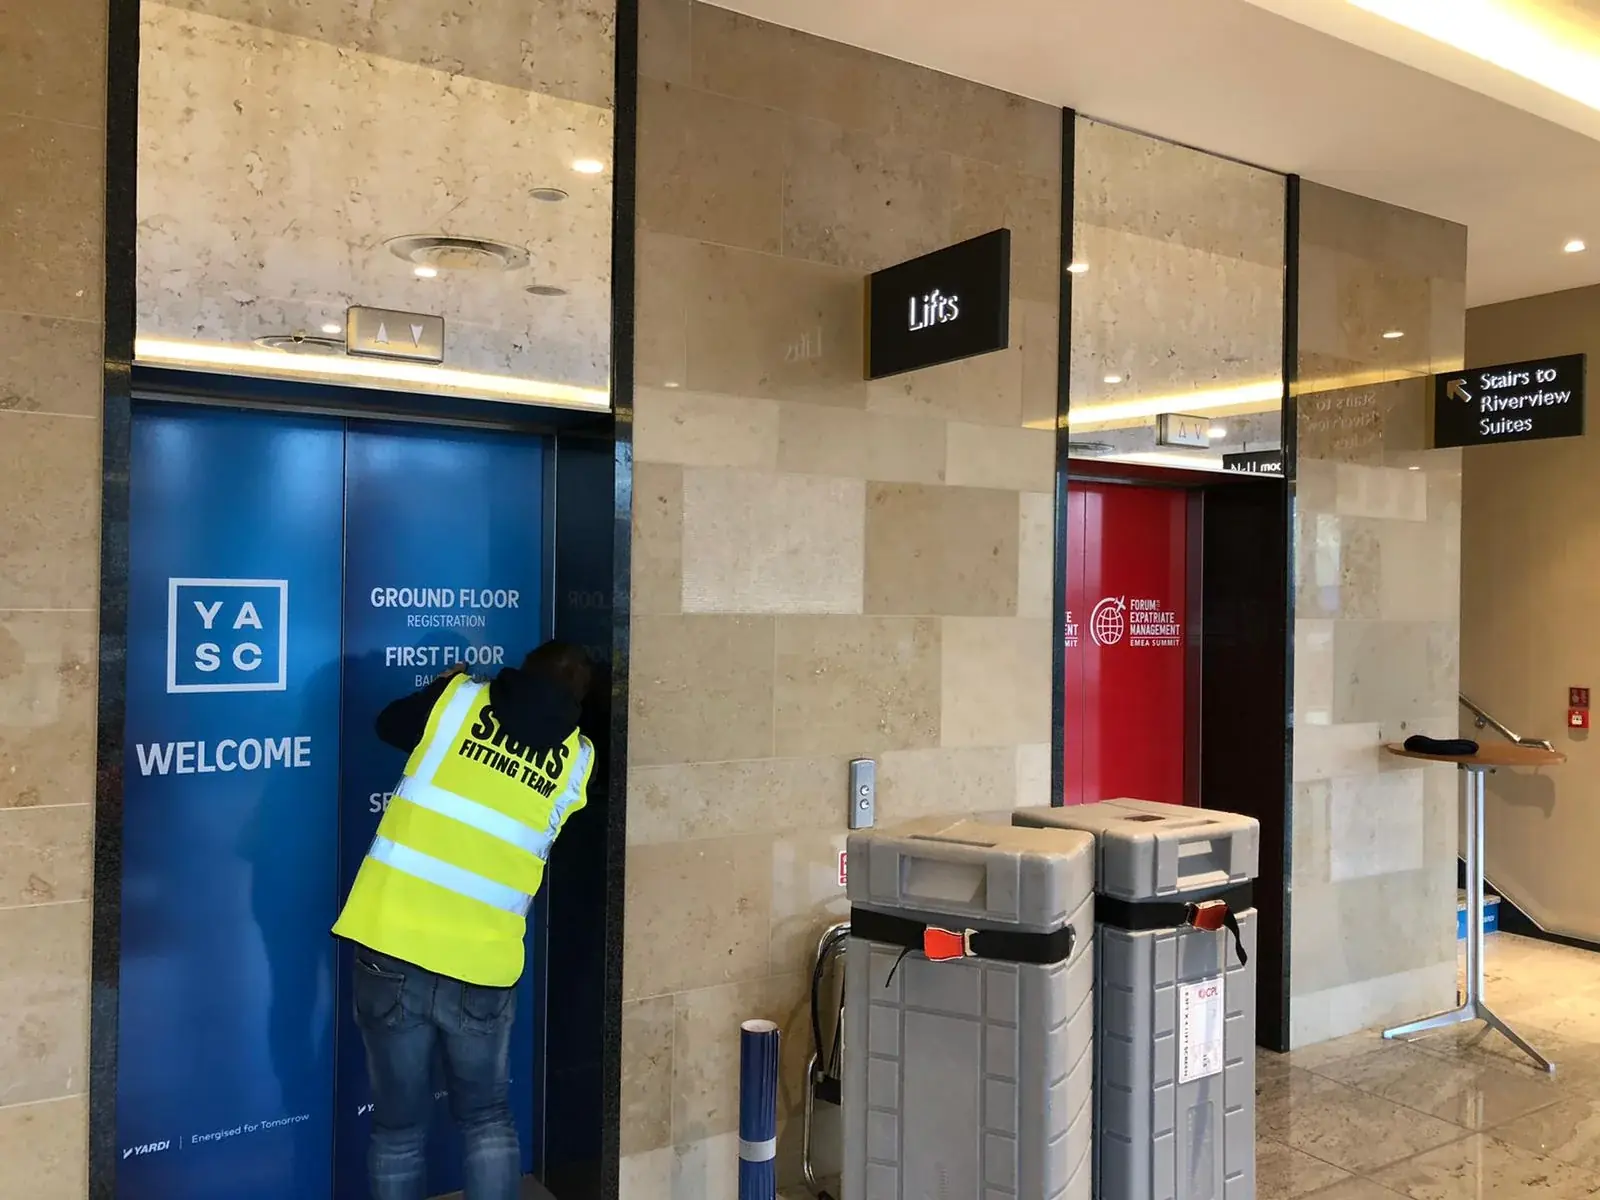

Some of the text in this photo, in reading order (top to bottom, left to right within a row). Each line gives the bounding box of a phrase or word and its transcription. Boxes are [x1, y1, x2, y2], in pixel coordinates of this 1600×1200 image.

[908, 288, 959, 332] Lifts
[1480, 368, 1557, 390] Stairs to
[1480, 389, 1571, 413] Riverview
[1479, 417, 1533, 436] Suites
[371, 587, 520, 608] GROUND FLOOR
[1130, 599, 1155, 611] FORUM
[407, 614, 485, 627] REGISTRATION
[1130, 612, 1175, 623] EXPATRIATE
[1130, 624, 1180, 635] MANAGEMENT
[1152, 639, 1180, 647] SUMMIT
[385, 646, 505, 666] FIRST FLOOR
[136, 736, 312, 776] WELCOME
[458, 739, 558, 798] FITTING TEAM
[191, 1113, 310, 1144] Energised for Tomorrow
[134, 1140, 171, 1156] YARDI
